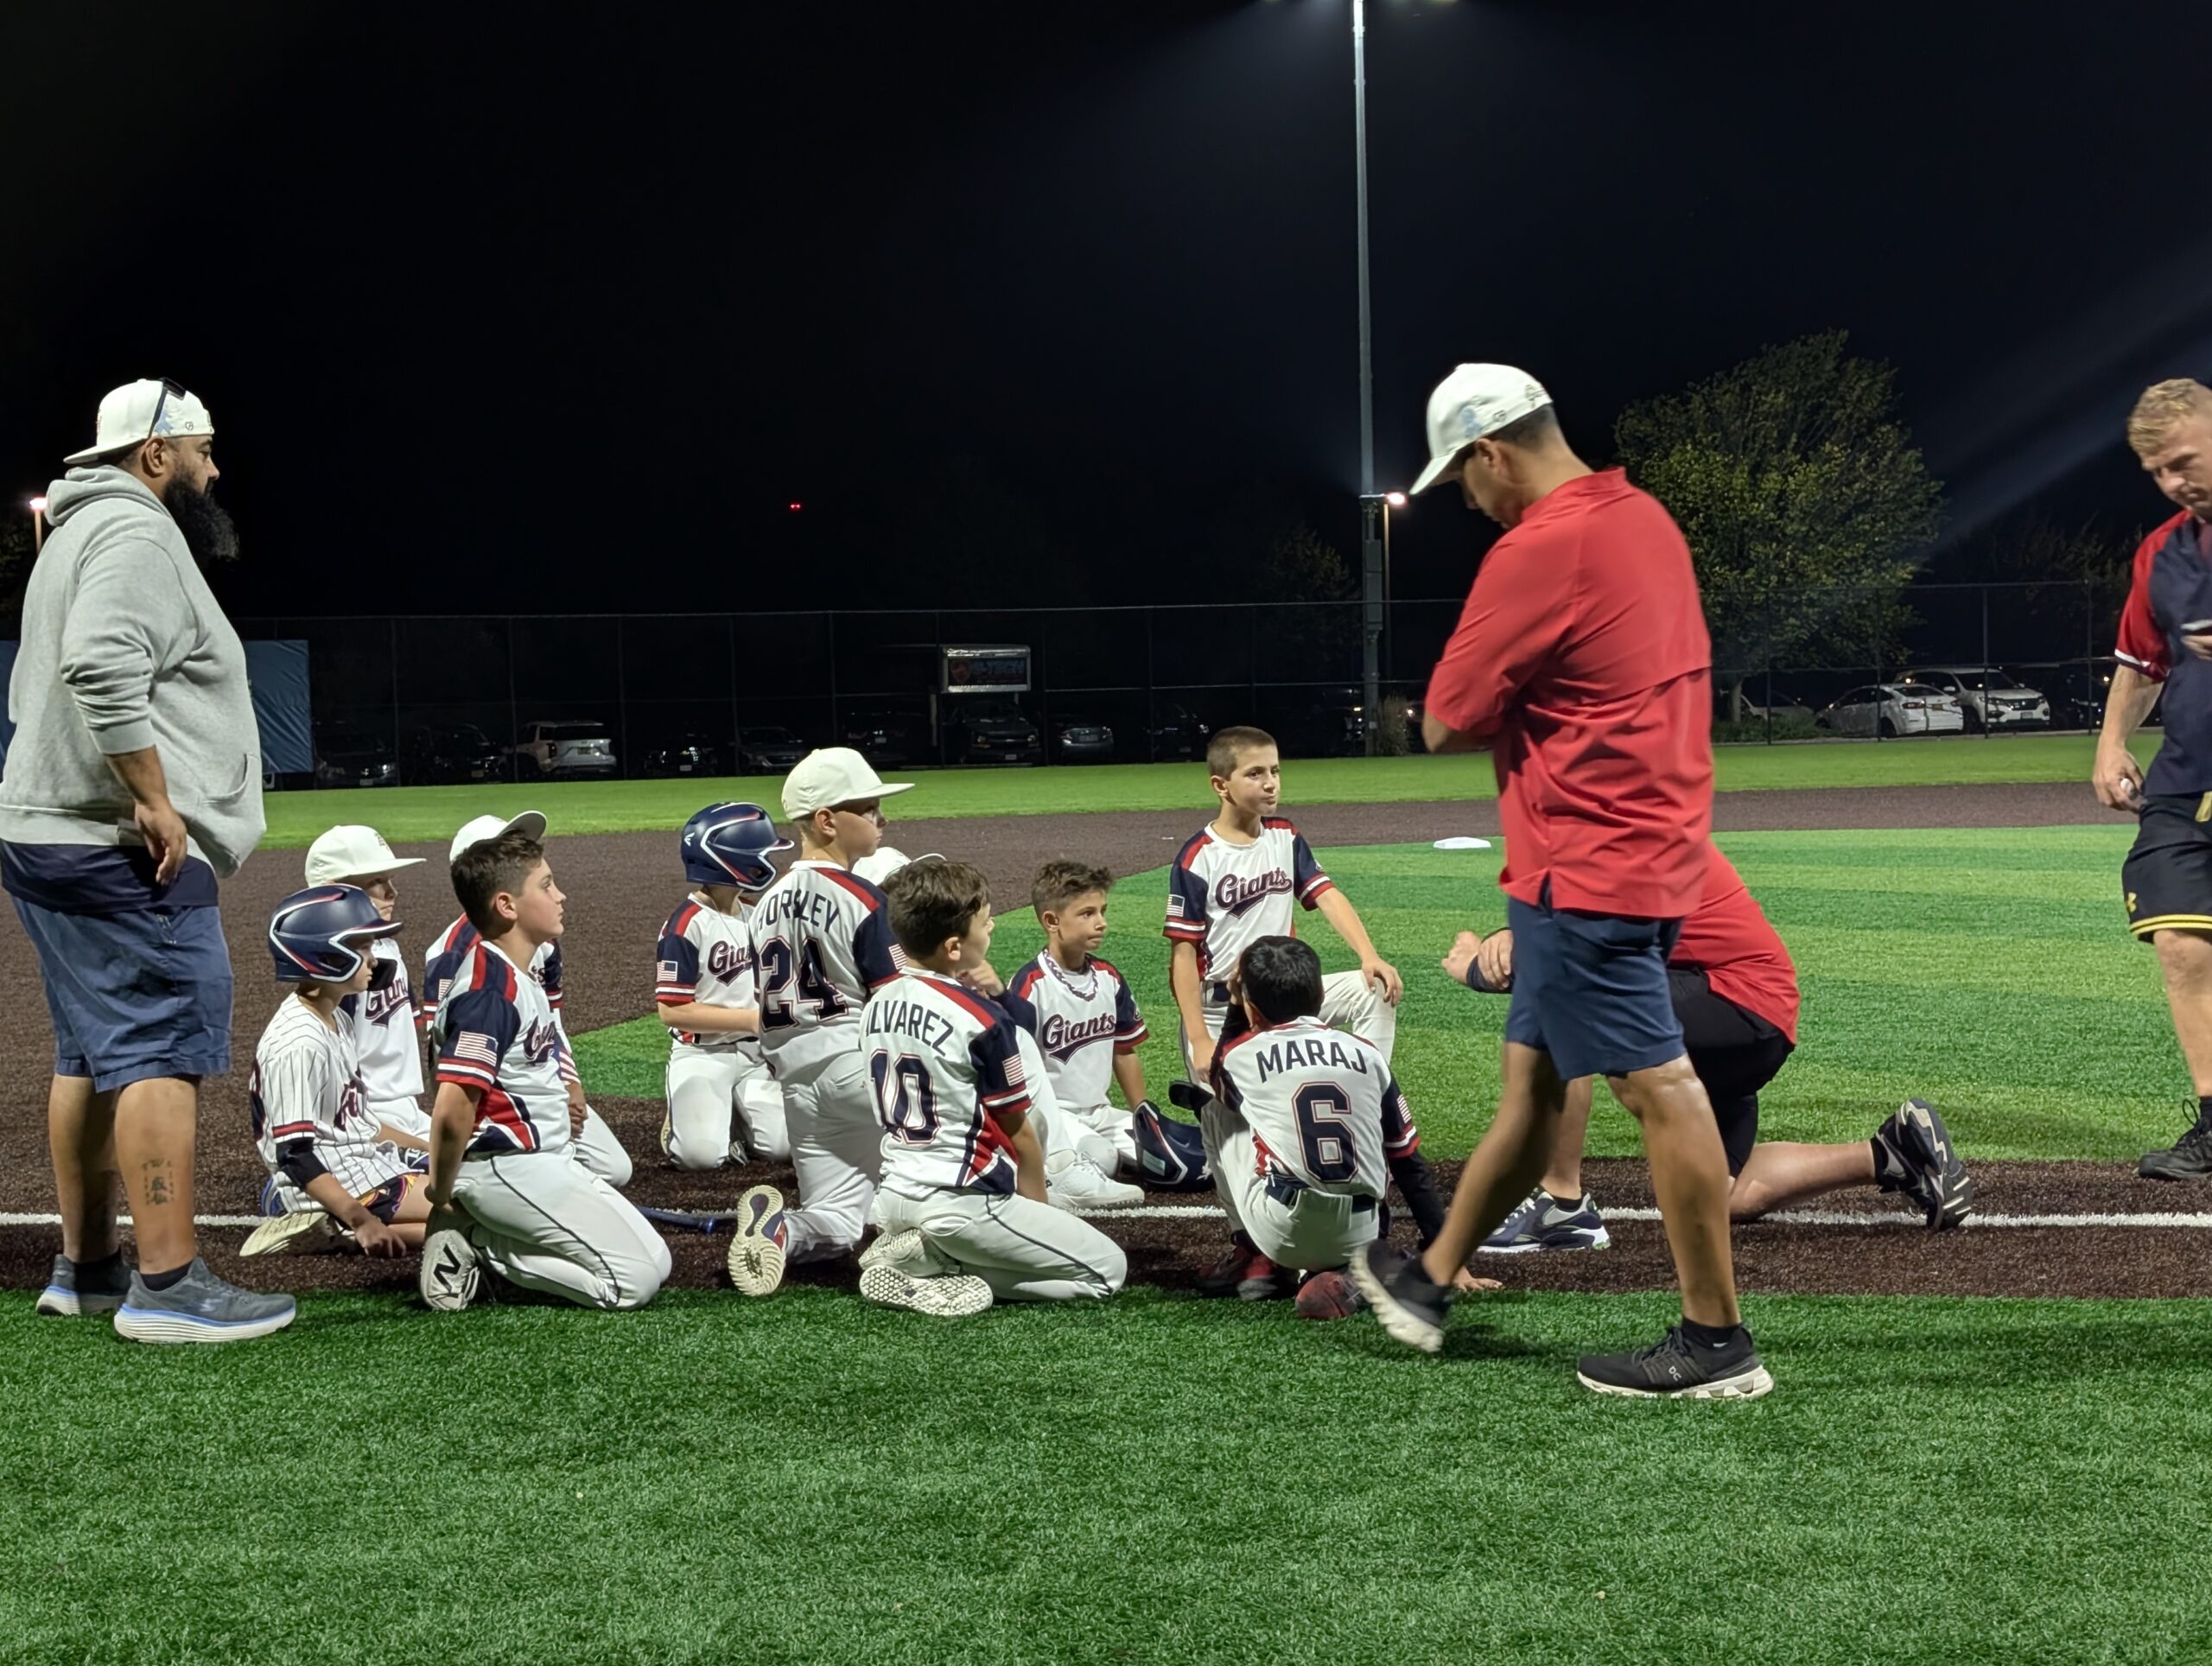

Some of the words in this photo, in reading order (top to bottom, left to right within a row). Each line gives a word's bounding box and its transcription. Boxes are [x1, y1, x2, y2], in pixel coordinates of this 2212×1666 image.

[1215, 866, 1294, 911] Giants
[759, 935, 849, 1033] 24
[866, 1000, 954, 1057] LVAREZ
[1042, 1013, 1116, 1052] Giants
[1255, 1039, 1367, 1083] MARAJ
[870, 1048, 941, 1145] 10
[1291, 1081, 1358, 1184] 6
